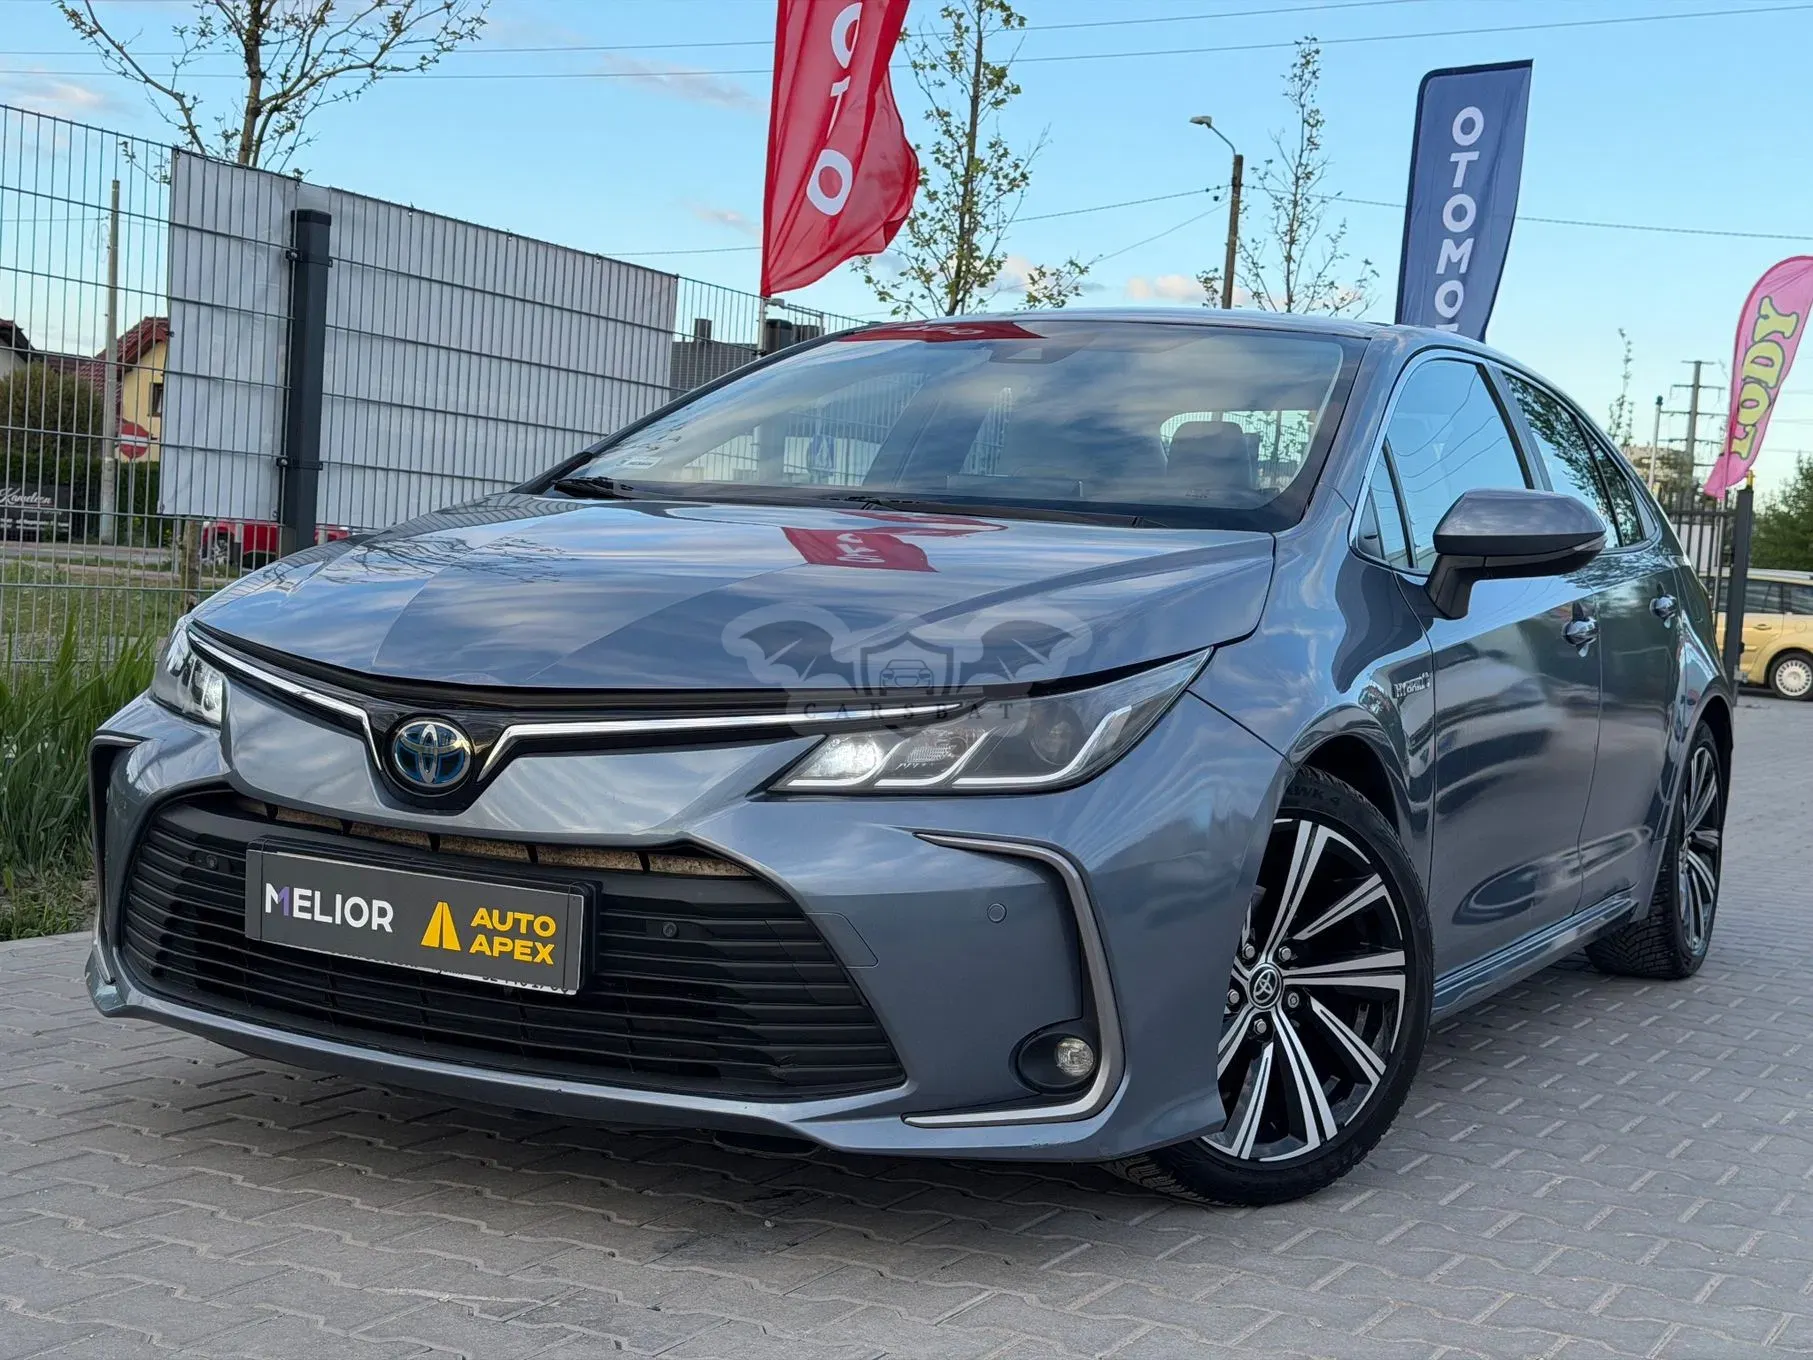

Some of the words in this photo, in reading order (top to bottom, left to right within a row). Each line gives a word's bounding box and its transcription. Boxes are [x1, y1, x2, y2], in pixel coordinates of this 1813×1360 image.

[1731, 295, 1800, 460] LODY
[265, 882, 394, 933] MELIOR
[470, 907, 557, 938] AUTO
[469, 934, 555, 965] APEX
